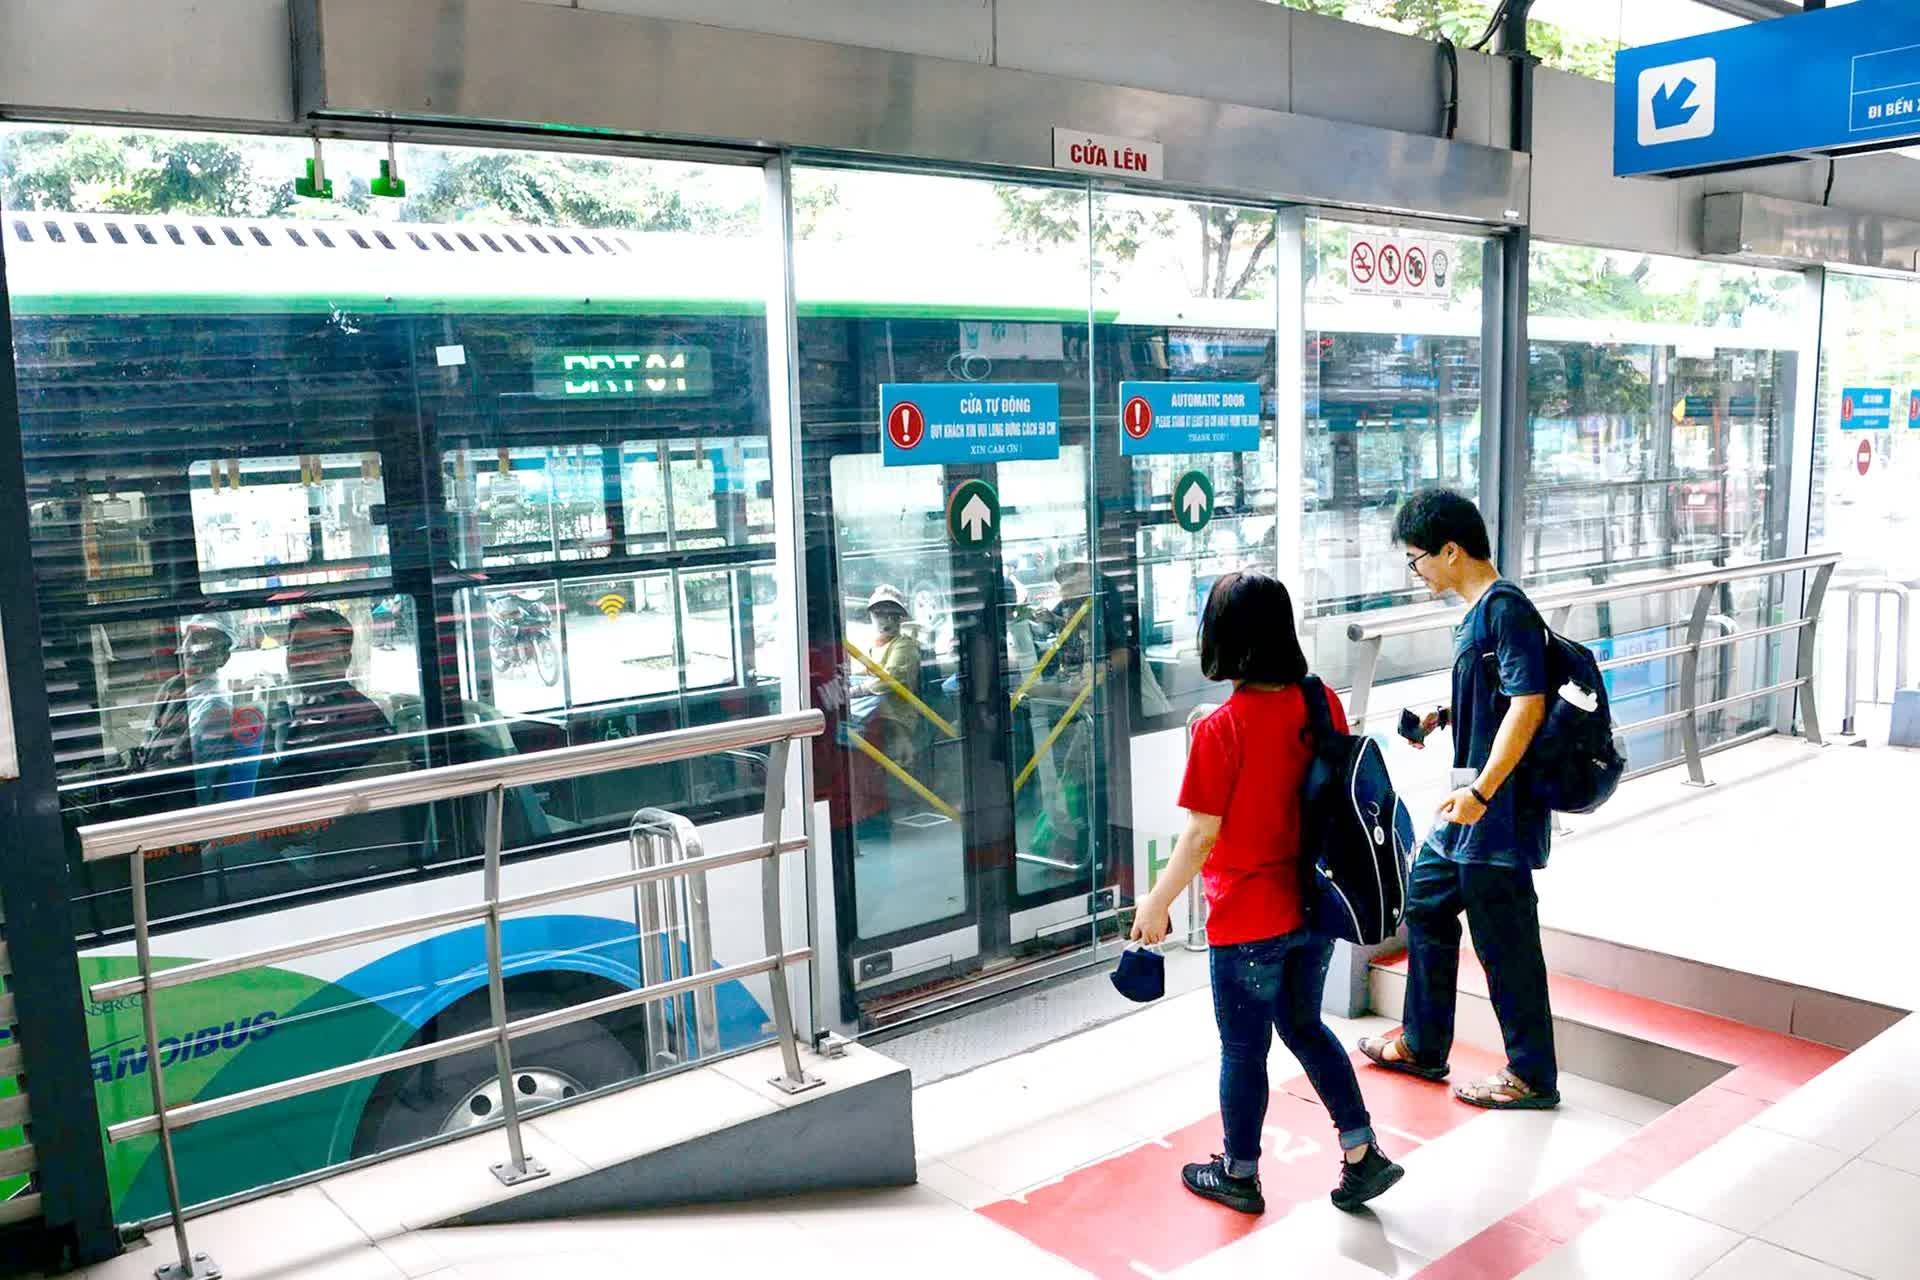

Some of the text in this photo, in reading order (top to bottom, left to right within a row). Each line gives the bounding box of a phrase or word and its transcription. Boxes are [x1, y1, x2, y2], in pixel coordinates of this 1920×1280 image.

[1885, 96, 1913, 117] BẾN
[1070, 138, 1147, 172] CỬA LÊN
[960, 392, 1031, 417] CỬA TỰ ĐỘNG
[1171, 393, 1245, 408] AUTOMATIC DOOR
[1187, 432, 1211, 442] THANK
[970, 445, 987, 455] XIN
